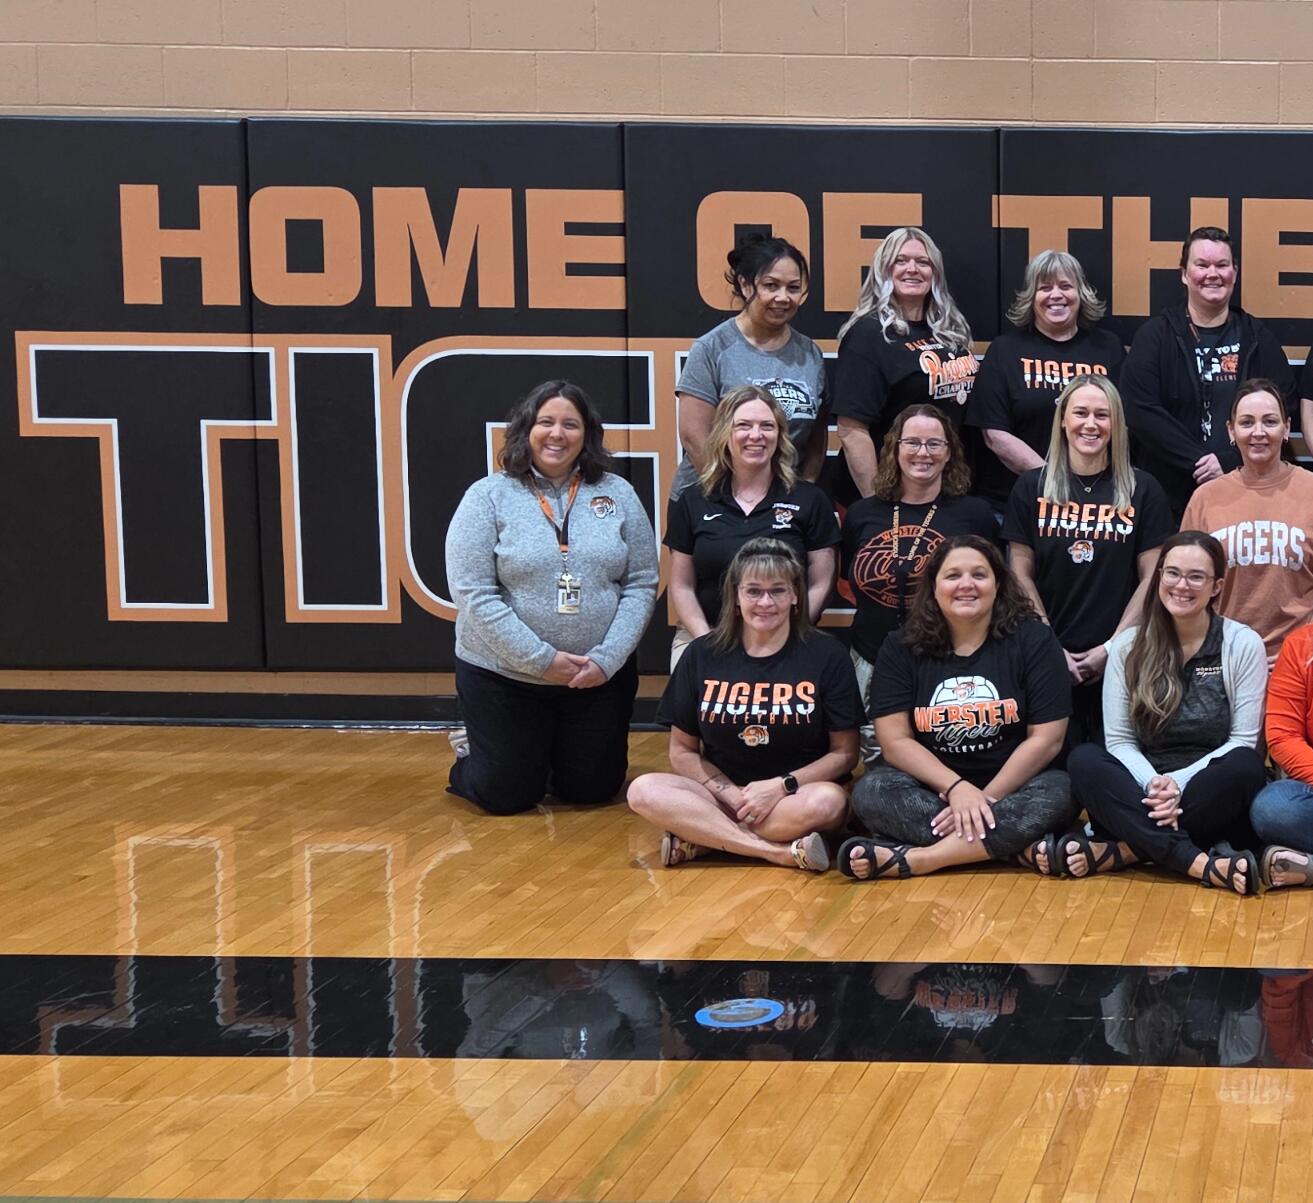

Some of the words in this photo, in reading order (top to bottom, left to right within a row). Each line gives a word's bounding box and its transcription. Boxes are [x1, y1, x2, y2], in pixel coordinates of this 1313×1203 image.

[119, 183, 626, 310] HOME
[696, 190, 923, 313] OF
[1037, 497, 1136, 535] TIGERS
[700, 679, 816, 716] TIGERS
[914, 698, 1020, 732] WEBSTER
[701, 710, 812, 725] VOLLEYBALL
[932, 720, 1004, 747] Tigers
